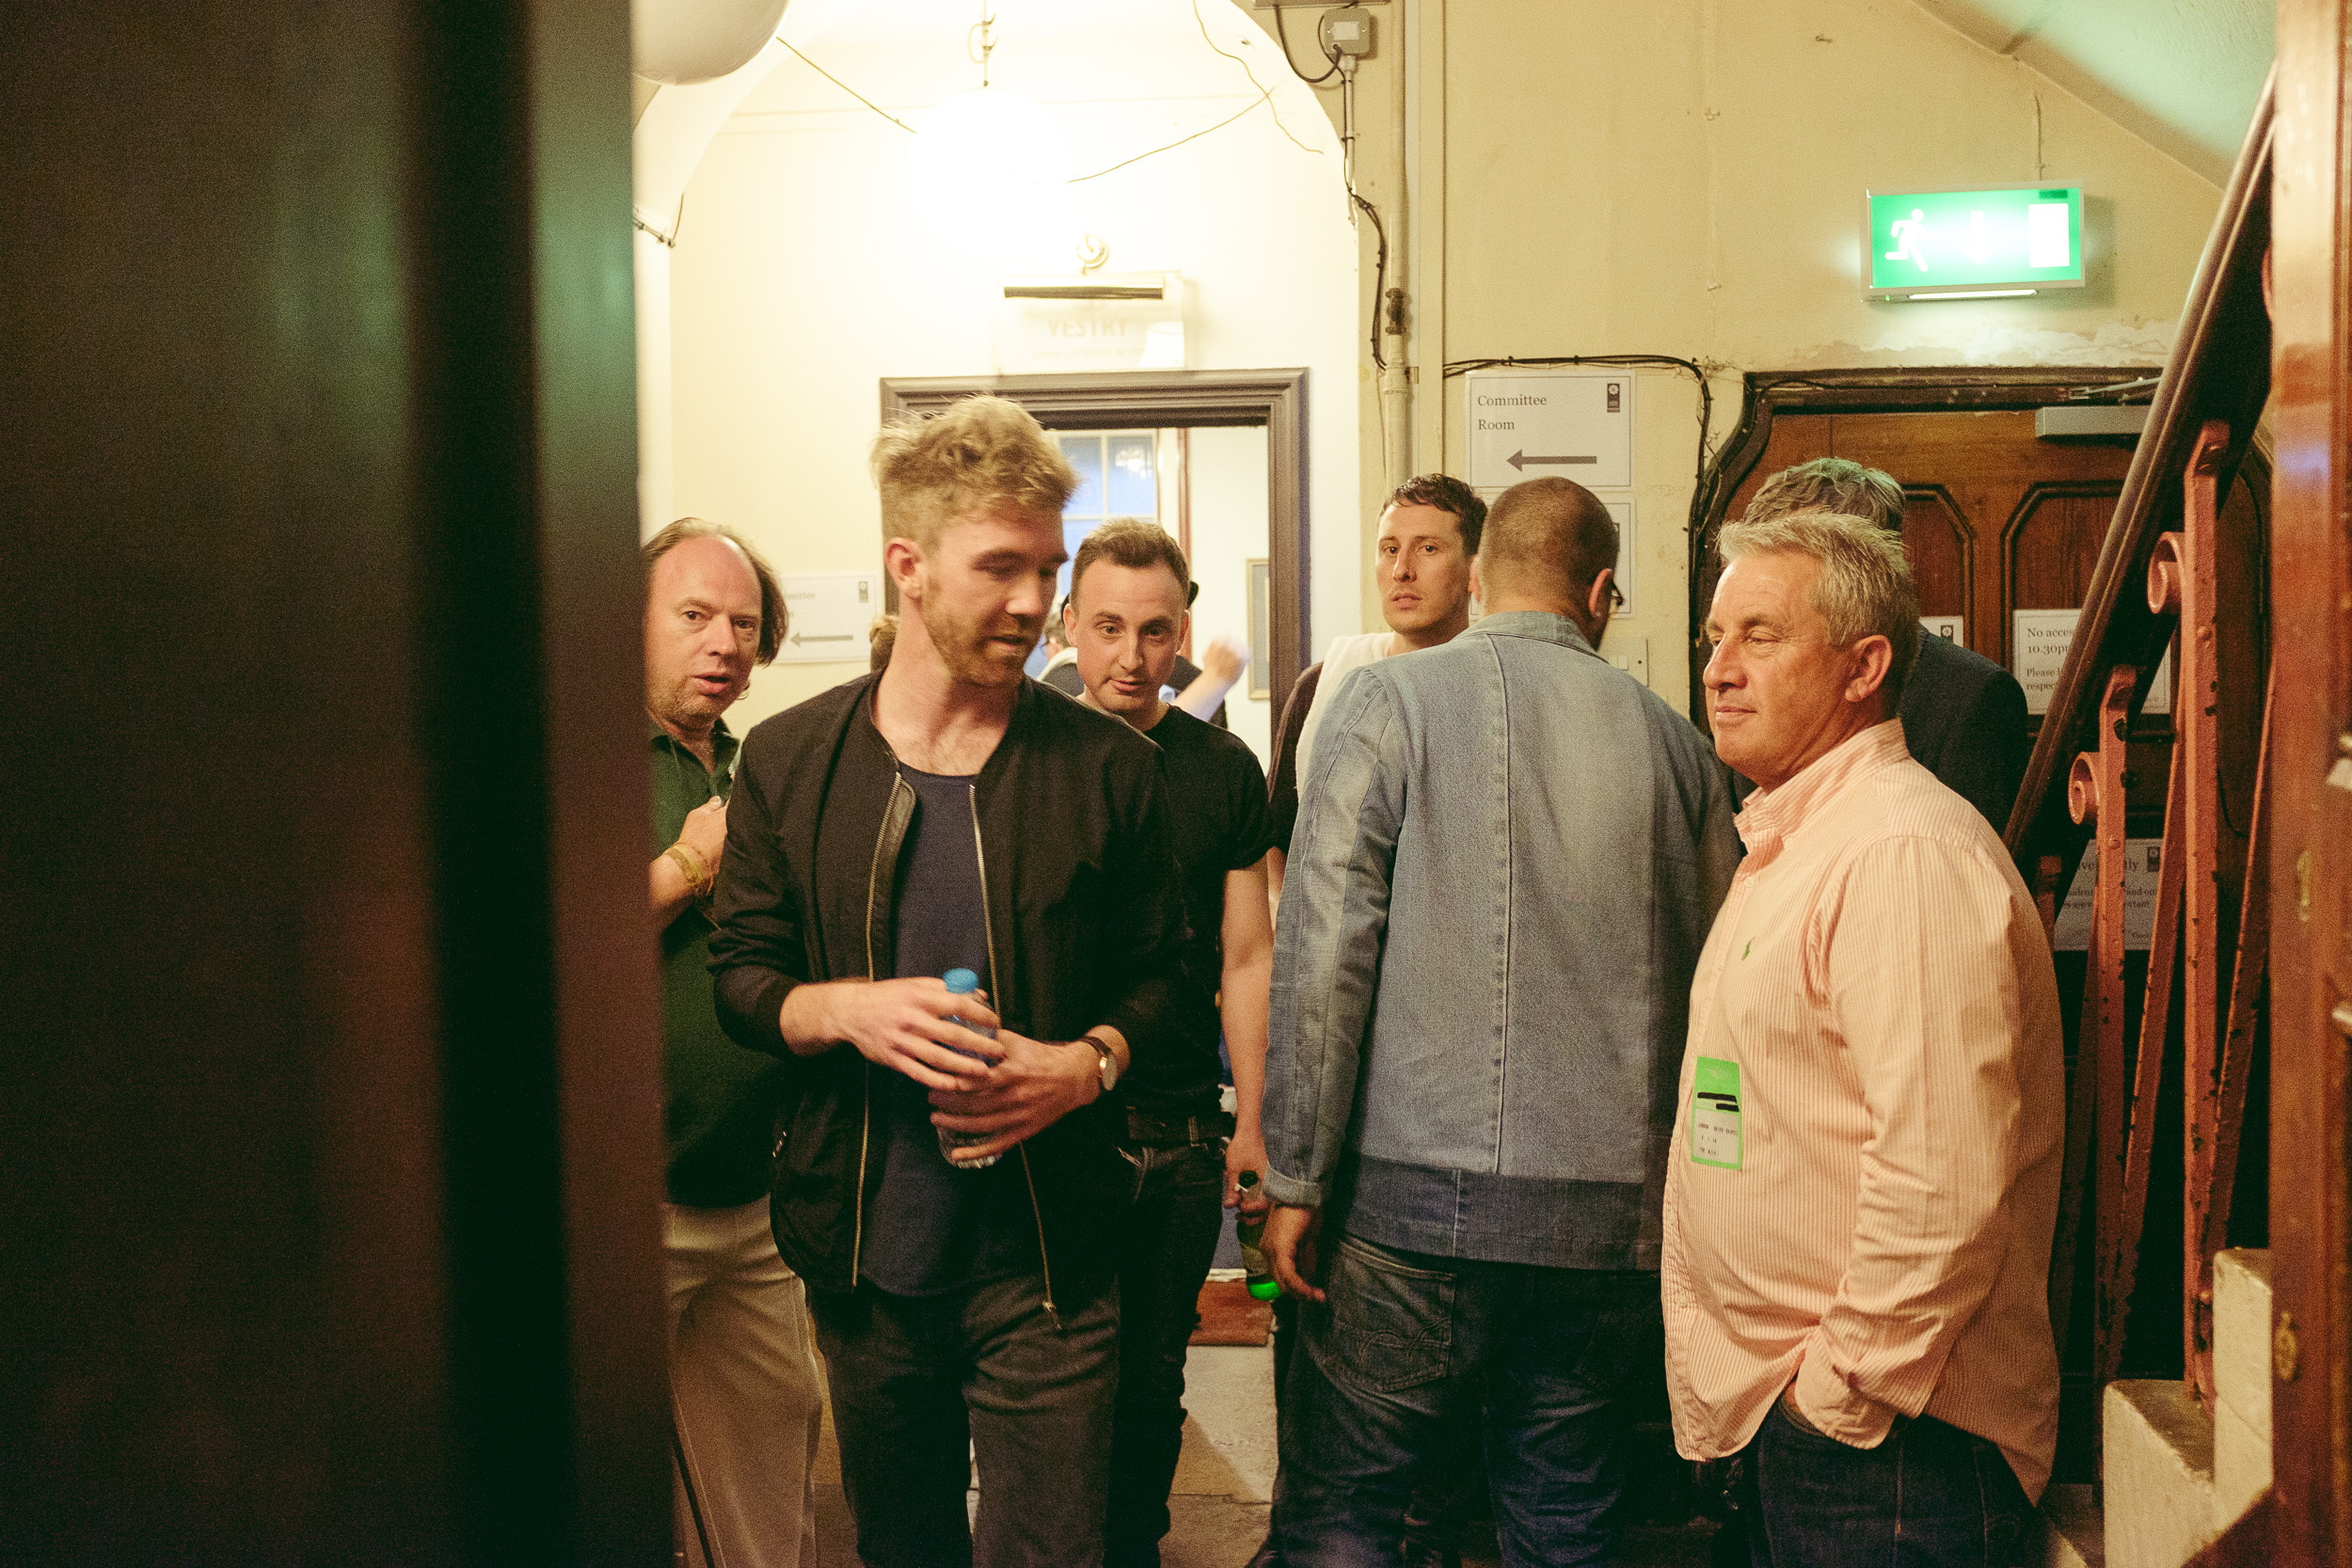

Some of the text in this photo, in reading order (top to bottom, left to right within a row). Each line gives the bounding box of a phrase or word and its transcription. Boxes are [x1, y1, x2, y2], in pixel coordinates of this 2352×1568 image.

[1047, 318, 1128, 338] VESTRY
[1477, 393, 1548, 406] Committee
[1478, 419, 1516, 431] Room
[2027, 627, 2074, 638] No acces
[2026, 667, 2056, 677] Please
